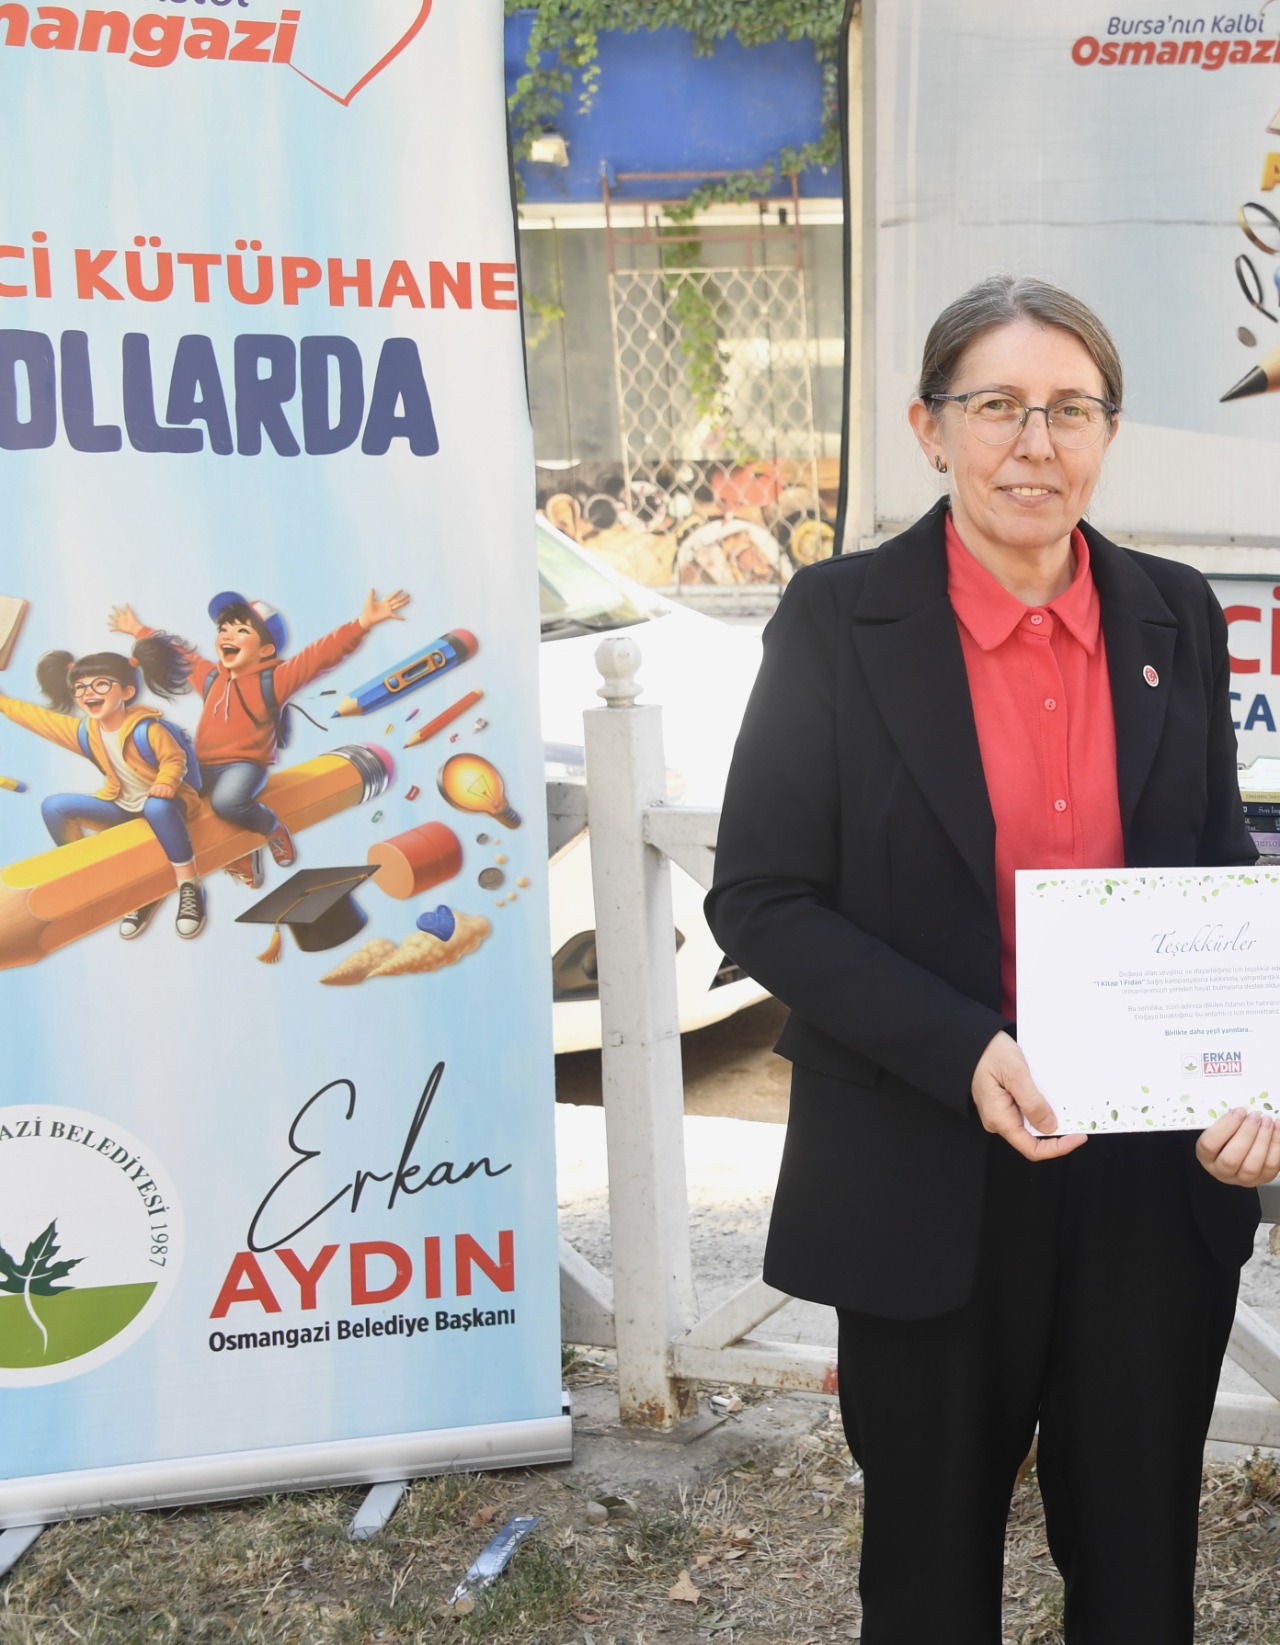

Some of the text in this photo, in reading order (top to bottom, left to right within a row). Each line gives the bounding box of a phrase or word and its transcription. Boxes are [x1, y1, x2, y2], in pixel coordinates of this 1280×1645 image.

[1211, 14, 1265, 33] Kalbi
[75, 236, 517, 311] KÜTÜPHANE
[0, 329, 440, 457] OLLARDA
[1151, 922, 1256, 956] Teşekkürler
[1203, 1051, 1241, 1062] ERKAN
[1205, 1062, 1240, 1073] AYDIN
[247, 1061, 512, 1253] Erkan
[49, 1120, 170, 1217] BELEDİYESİ
[148, 1223, 169, 1267] 1987
[208, 1229, 515, 1319] AYDIN
[208, 1307, 516, 1352] Osmangazi Belediye Başkanı
